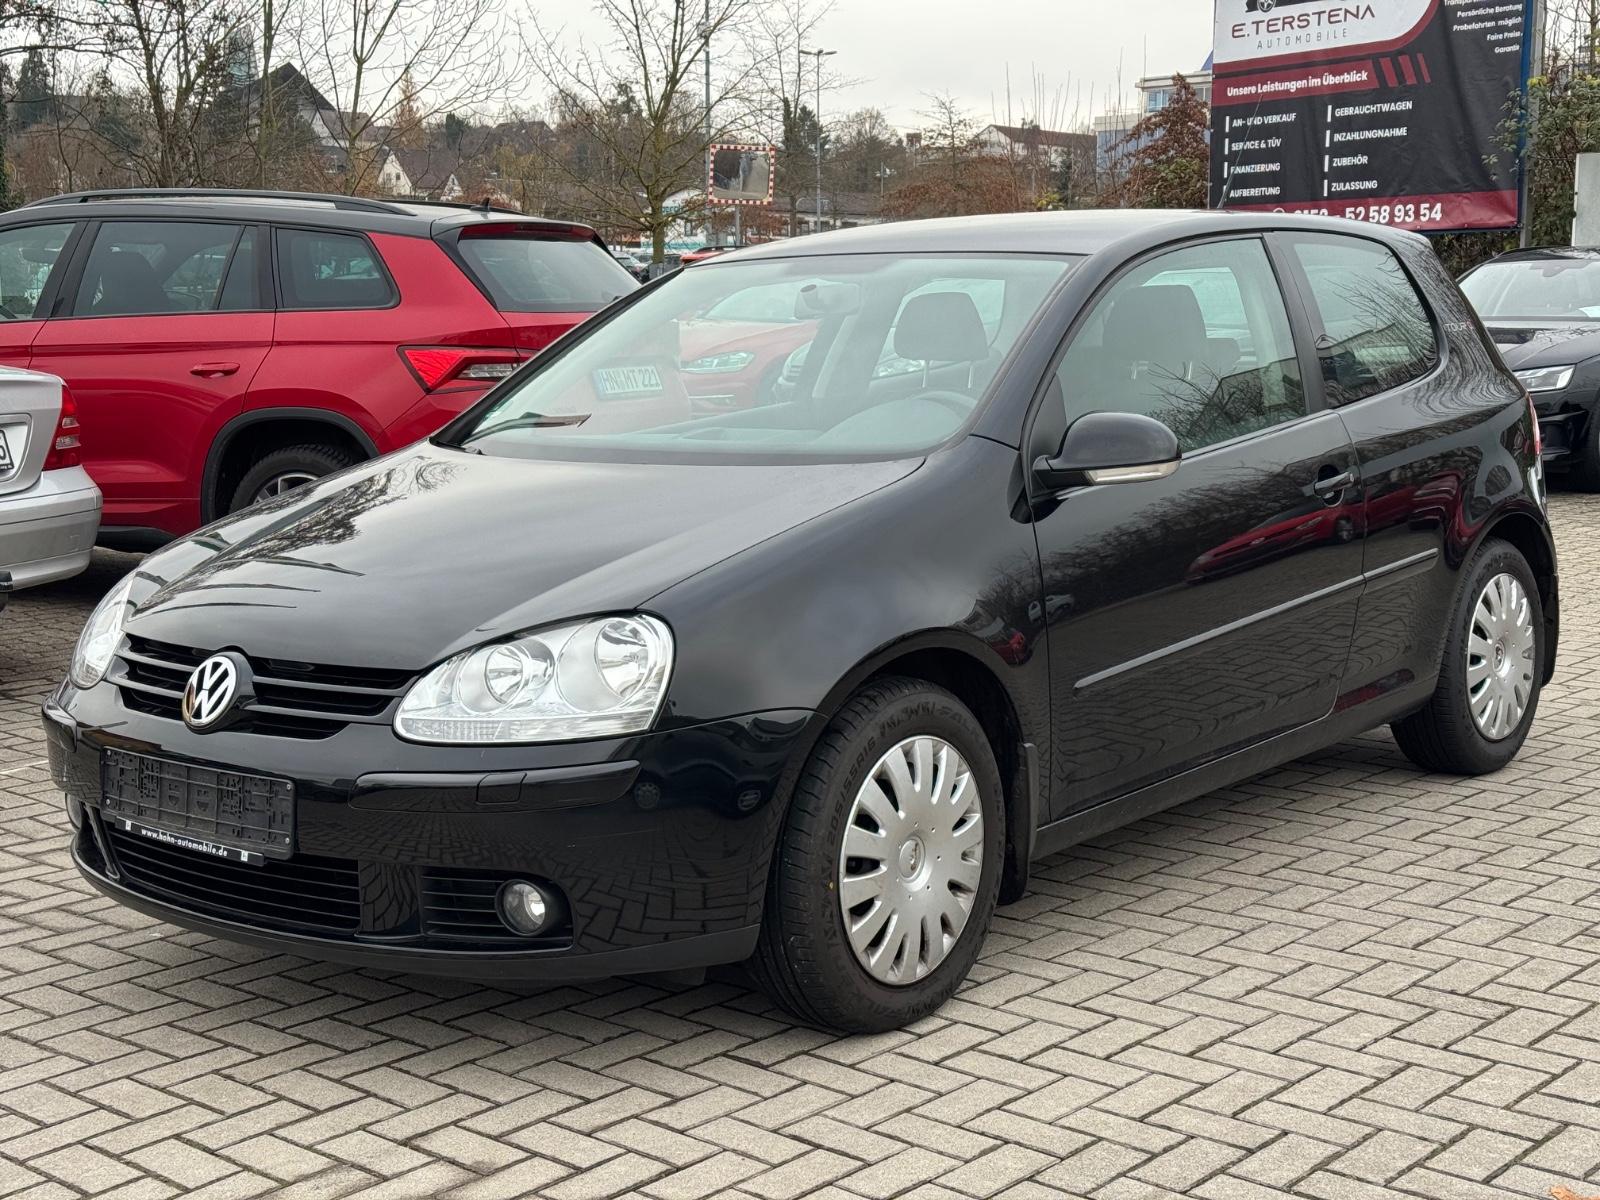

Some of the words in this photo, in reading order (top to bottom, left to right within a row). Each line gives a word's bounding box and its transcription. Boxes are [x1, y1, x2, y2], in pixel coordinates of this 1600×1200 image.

[1457, 7, 1494, 17] Persönliche
[1495, 3, 1523, 12] Beratung
[1232, 4, 1375, 38] E.TERSTENA
[1453, 20, 1496, 31] Probefahrten
[1257, 28, 1348, 49] AUTOMOBILE
[1487, 33, 1504, 41] Faire
[1227, 85, 1257, 97] Unsere
[1258, 78, 1307, 93] Leistungen
[1309, 76, 1321, 86] im
[1322, 70, 1368, 85] Überblick
[1335, 101, 1413, 117] GEBRAUCHTWAGEN
[1232, 119, 1246, 127] AN-
[1247, 117, 1263, 126] UND
[1264, 113, 1297, 124] VERKAUF
[1333, 127, 1407, 142] INZAHLUNGNAHME
[1231, 140, 1259, 151] SERVICE
[1260, 140, 1266, 149] &
[1267, 137, 1281, 148] TÜV
[1333, 153, 1368, 167] ZUBEHÖR
[1229, 186, 1281, 198] AUFBEREITUNG
[1331, 180, 1378, 191] ZULASSUNG
[1369, 205, 1390, 223] 58
[1394, 204, 1415, 222] 93
[1419, 203, 1442, 222] 54
[141, 828, 228, 857] www.hahn-automobile.de
